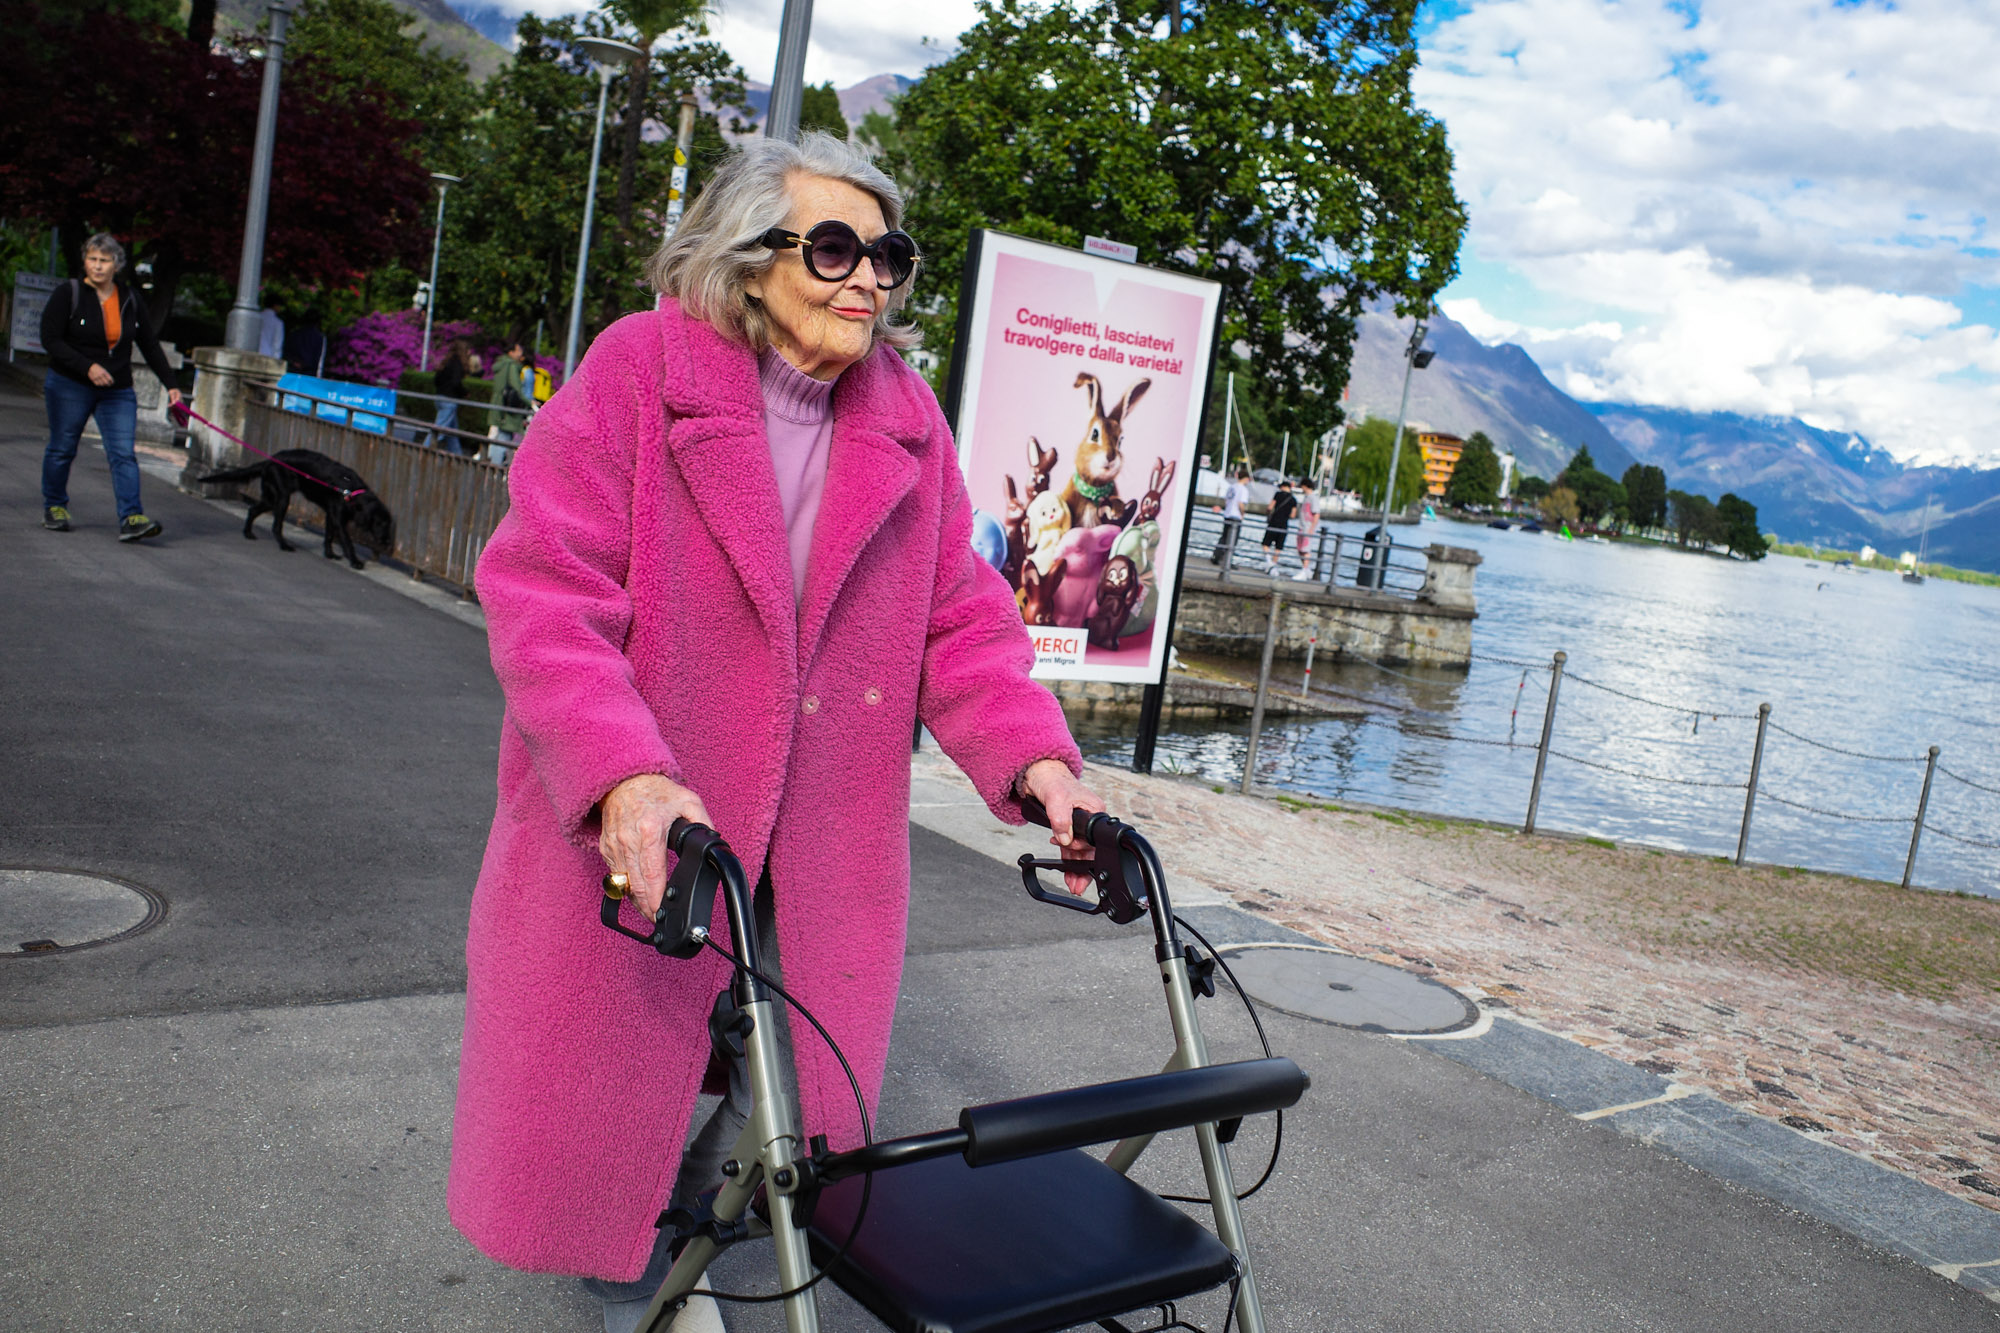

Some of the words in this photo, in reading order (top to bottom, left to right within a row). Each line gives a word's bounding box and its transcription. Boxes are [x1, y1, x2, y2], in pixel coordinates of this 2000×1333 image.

[1004, 327, 1085, 356] travolgere
[1088, 343, 1125, 364] dalla
[1128, 354, 1183, 376] varietà!
[1016, 307, 1100, 342] Coniglietti,
[1104, 324, 1175, 353] lasciatevi
[1054, 657, 1075, 665] Migros
